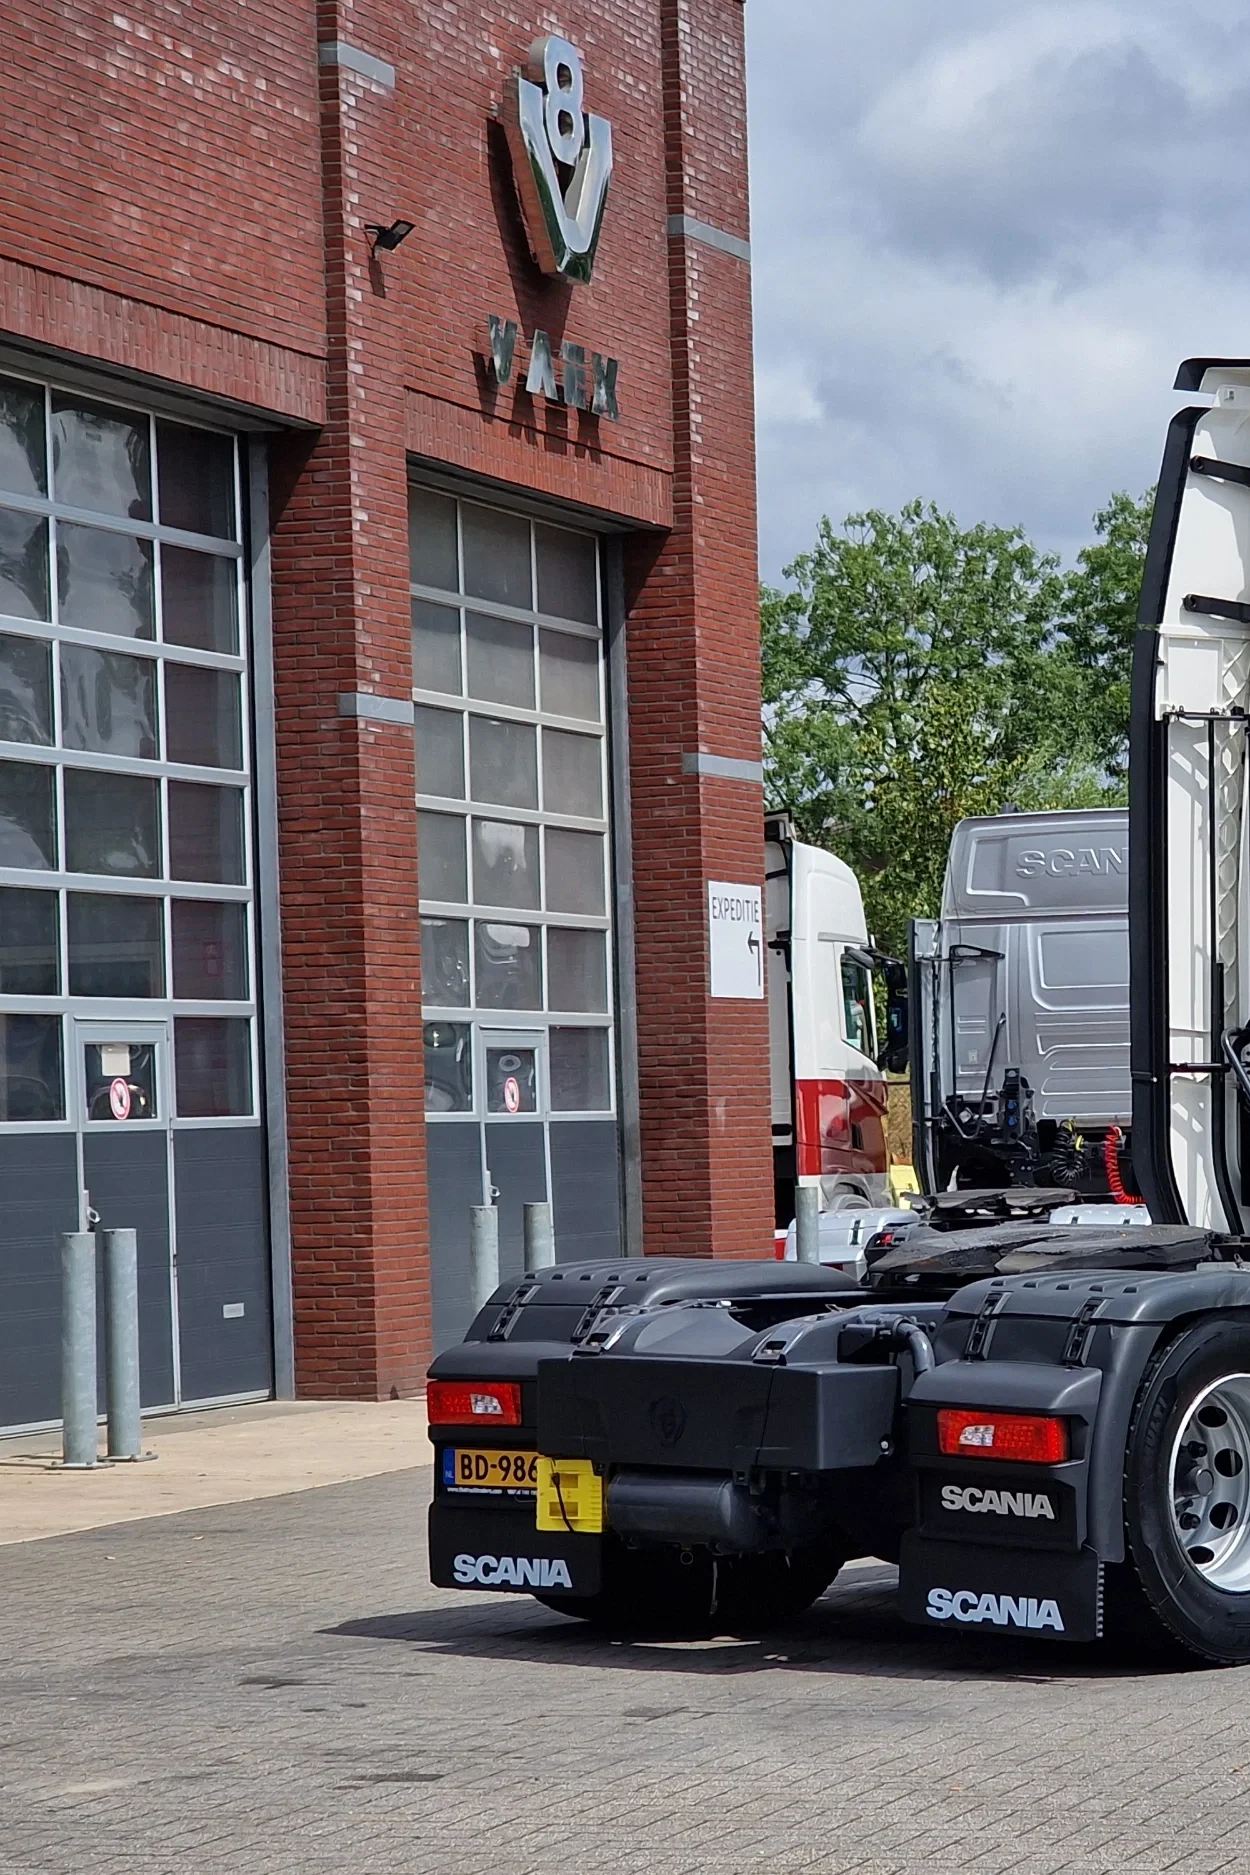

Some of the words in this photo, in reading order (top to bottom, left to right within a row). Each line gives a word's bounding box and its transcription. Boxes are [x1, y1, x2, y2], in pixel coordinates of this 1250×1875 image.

[712, 896, 760, 923] EXPEDITIE
[941, 1485, 1055, 1520] SCANIA
[453, 1554, 573, 1588] SCANIA
[926, 1588, 1065, 1631] SCANIA
